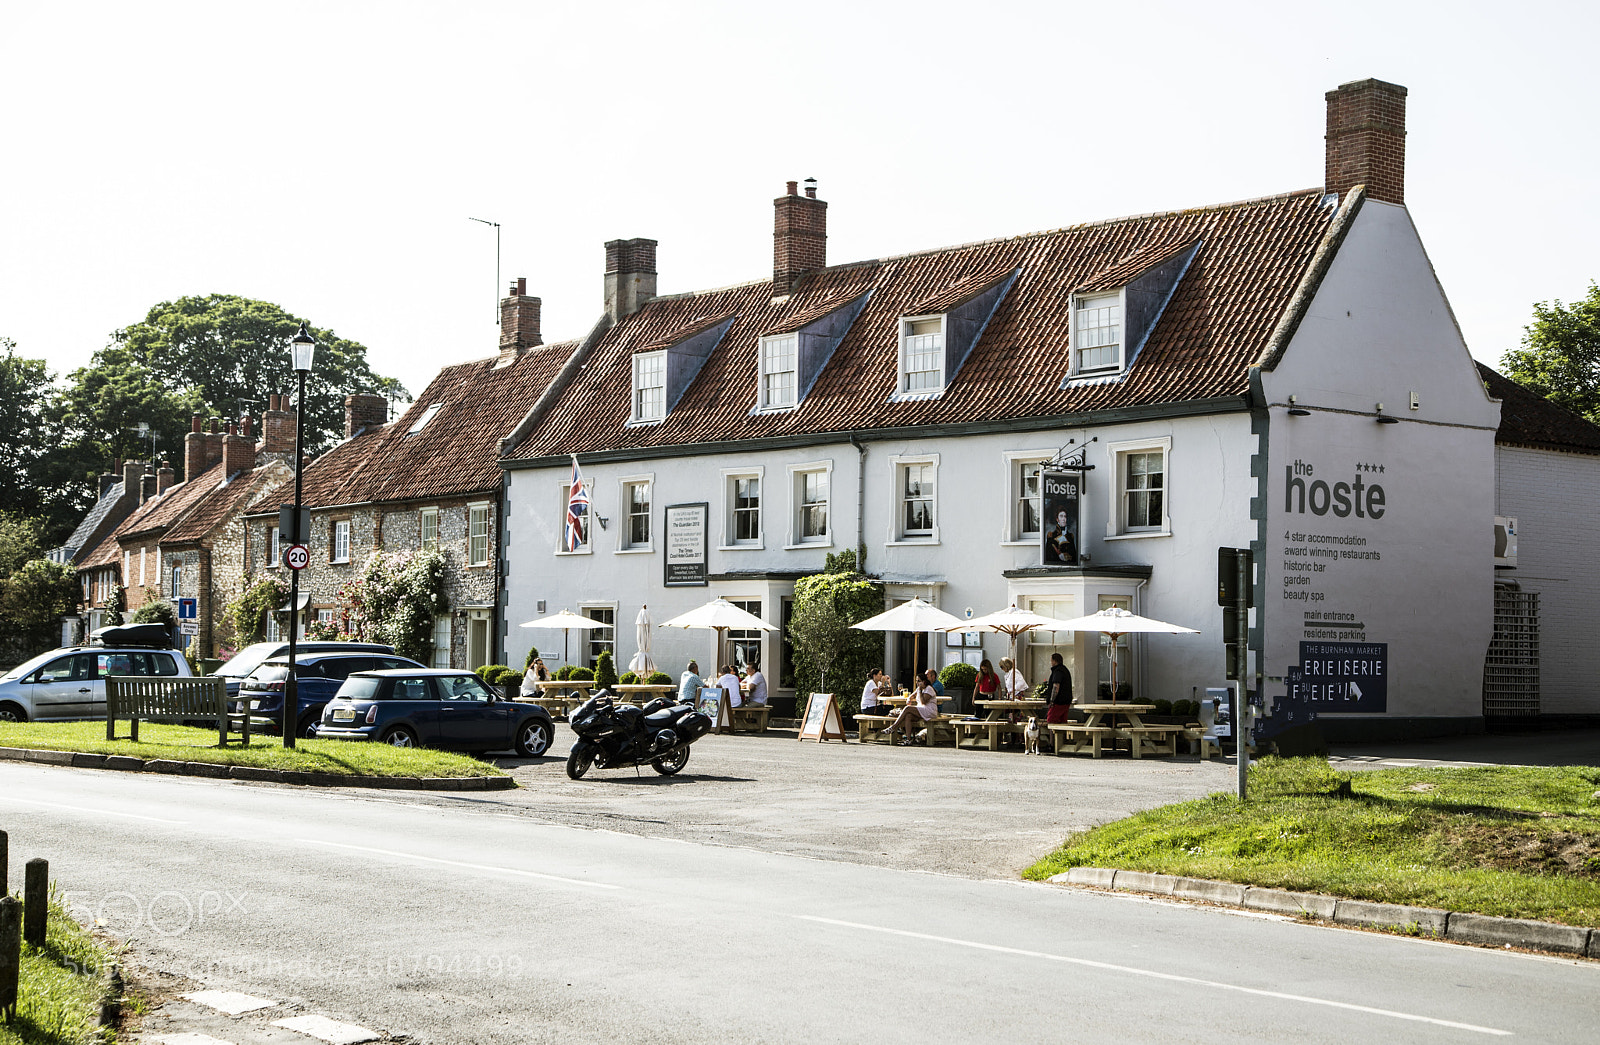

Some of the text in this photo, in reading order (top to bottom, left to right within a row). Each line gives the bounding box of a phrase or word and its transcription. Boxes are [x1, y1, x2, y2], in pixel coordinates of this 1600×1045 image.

[1294, 459, 1313, 476] the
[1046, 480, 1077, 495] hoste
[1285, 465, 1385, 520] hoste
[1284, 530, 1367, 546] 4 star accommodation
[291, 552, 307, 563] 20
[1284, 546, 1381, 560] award winning restaurants
[1283, 560, 1326, 572] historic bar
[1283, 575, 1311, 587] garden
[1283, 589, 1325, 602] beauty spa
[1304, 610, 1355, 621] main entrance
[1304, 628, 1366, 641] residents parking
[1306, 645, 1382, 655] THE BURNHAM MARKET
